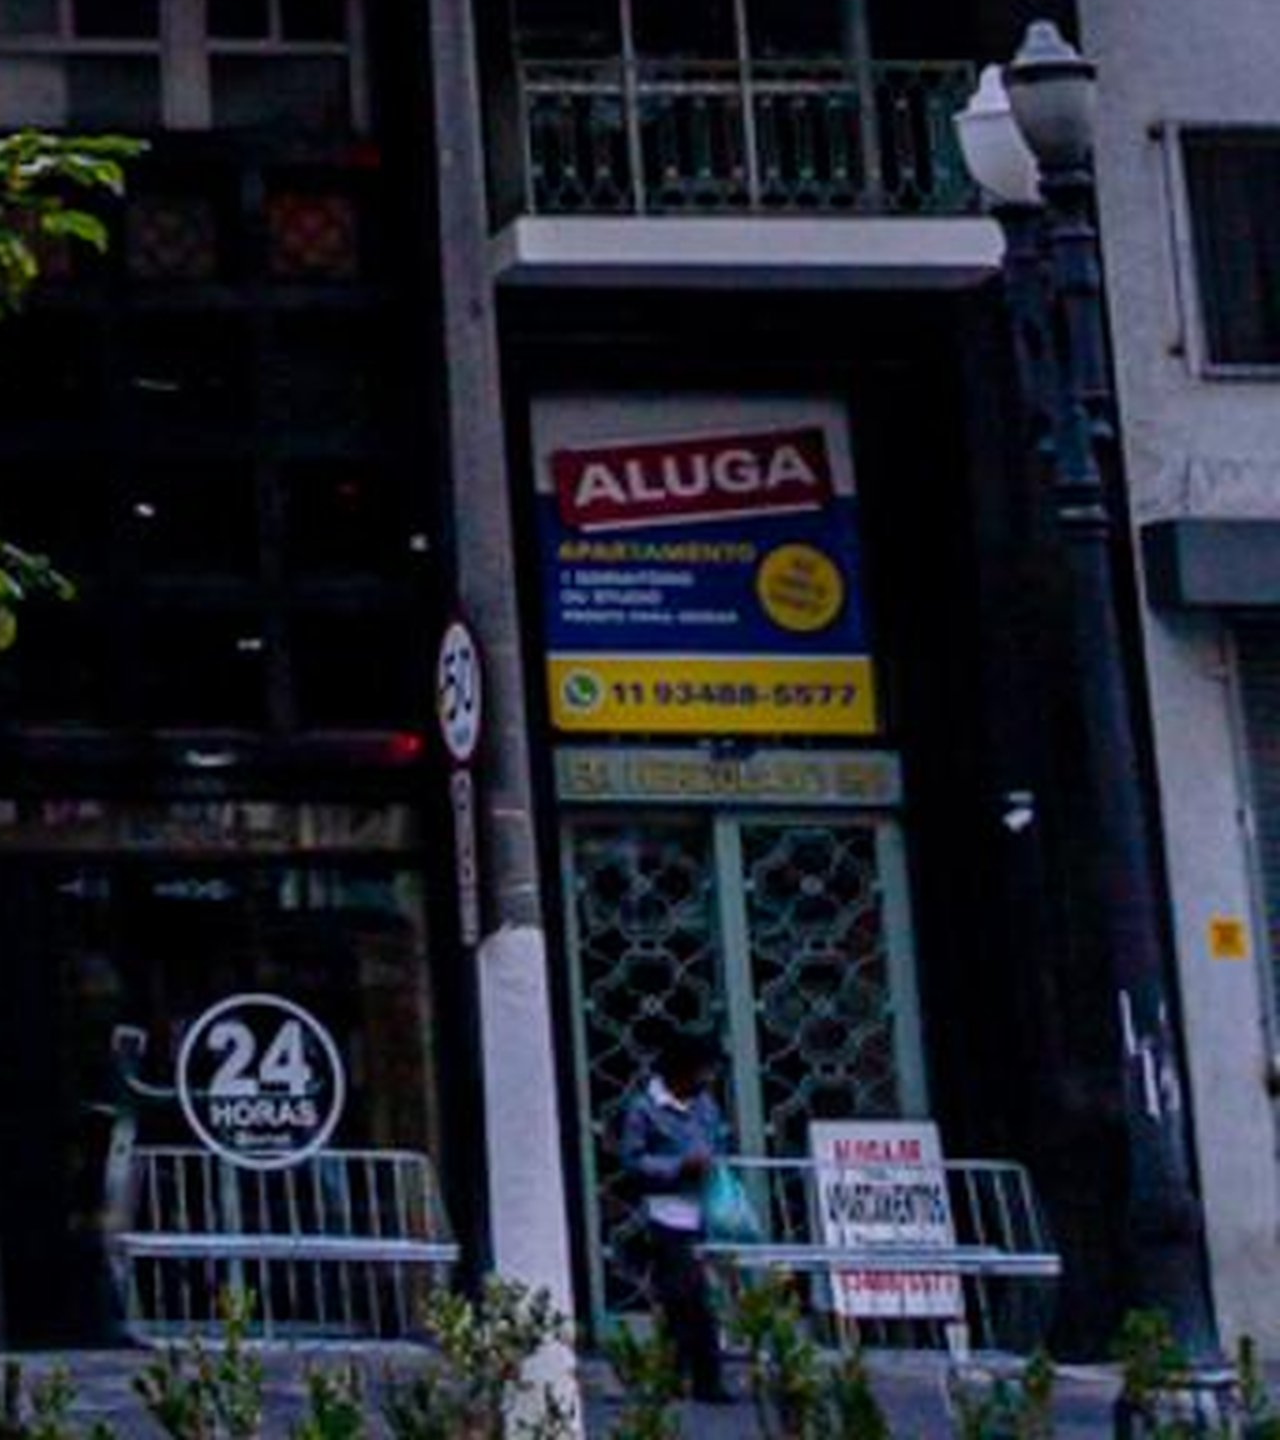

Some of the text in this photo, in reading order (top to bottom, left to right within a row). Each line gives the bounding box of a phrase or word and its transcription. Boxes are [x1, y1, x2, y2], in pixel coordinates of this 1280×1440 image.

[574, 444, 817, 508] ALUGA
[559, 540, 756, 563] APARTAMENTO
[613, 681, 644, 705] 11
[206, 1017, 313, 1097] 24
[208, 1098, 319, 1129] HORAS
